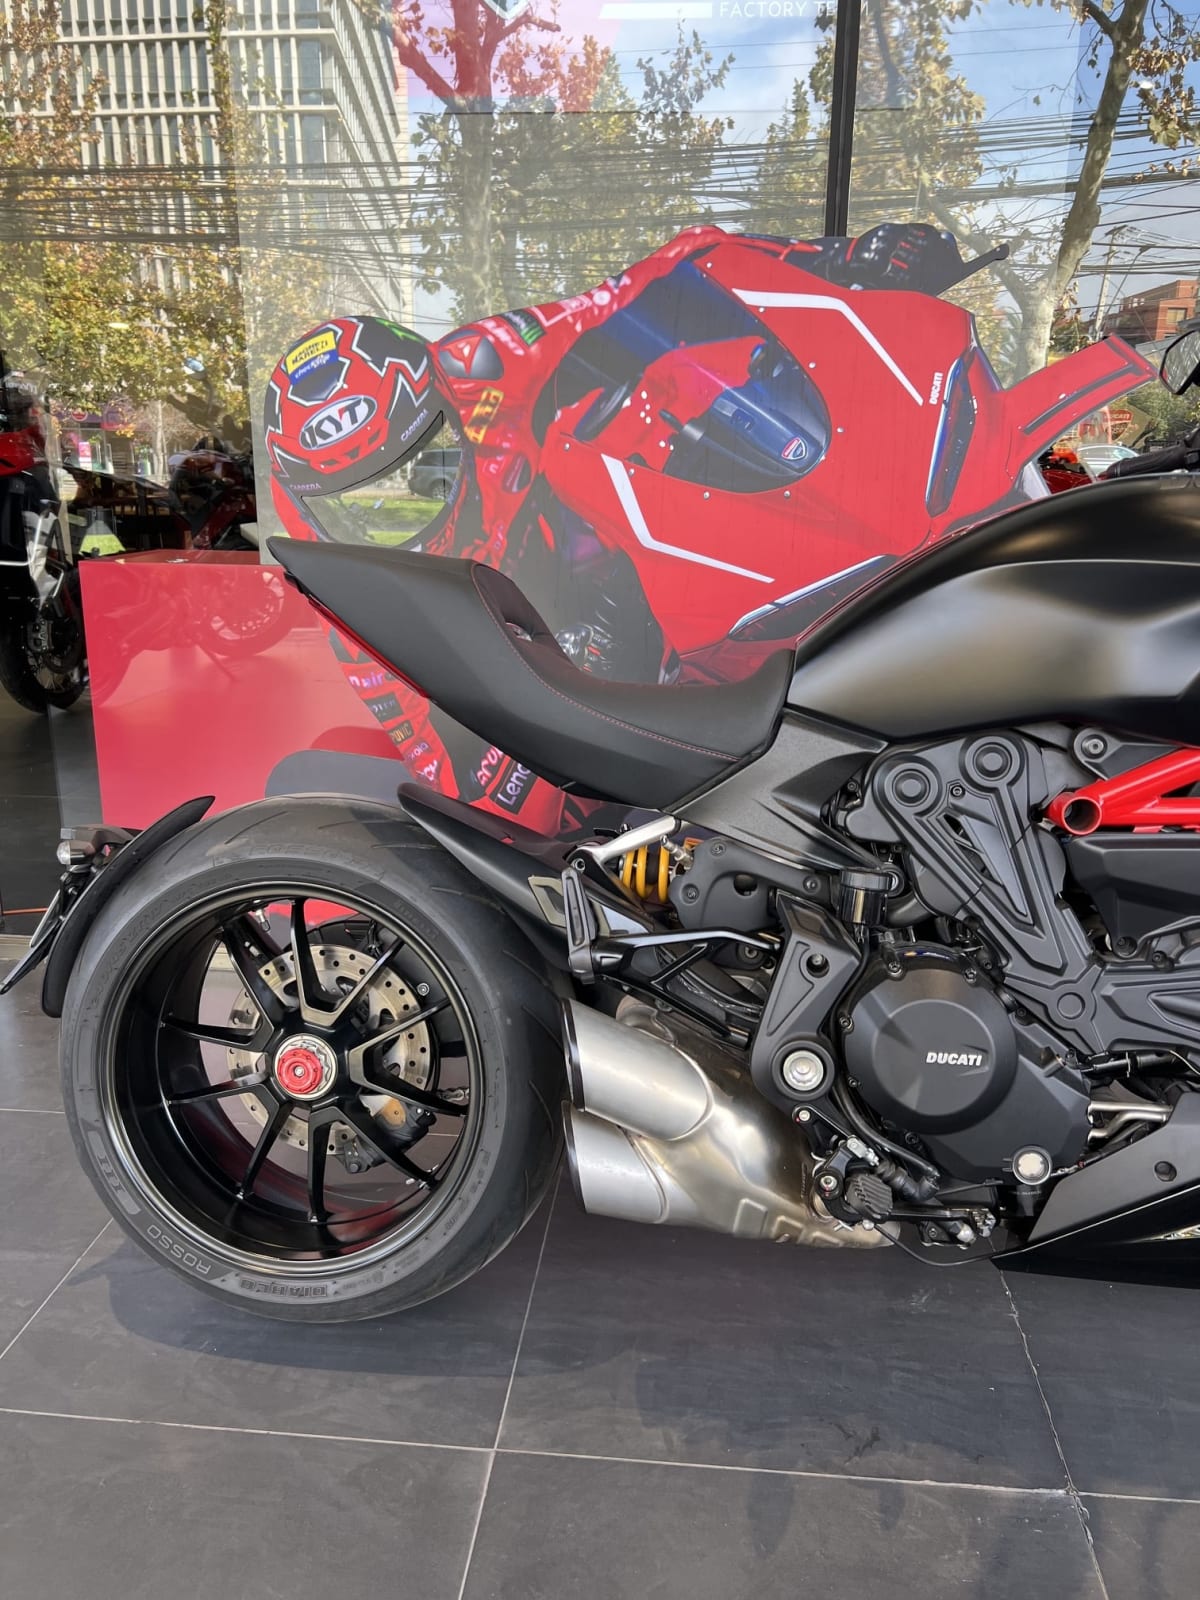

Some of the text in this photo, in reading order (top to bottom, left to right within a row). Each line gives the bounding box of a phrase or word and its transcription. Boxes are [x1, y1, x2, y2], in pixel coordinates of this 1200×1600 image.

[719, 1, 869, 18] FACTORY TEM
[929, 371, 943, 405] DUCATI
[305, 398, 364, 447] KYT
[400, 408, 429, 442] CARRERA
[476, 745, 504, 787] aru
[925, 1051, 983, 1067] DUCATI
[146, 1223, 212, 1275] ROSSO
[239, 1278, 328, 1297] DIABLO
